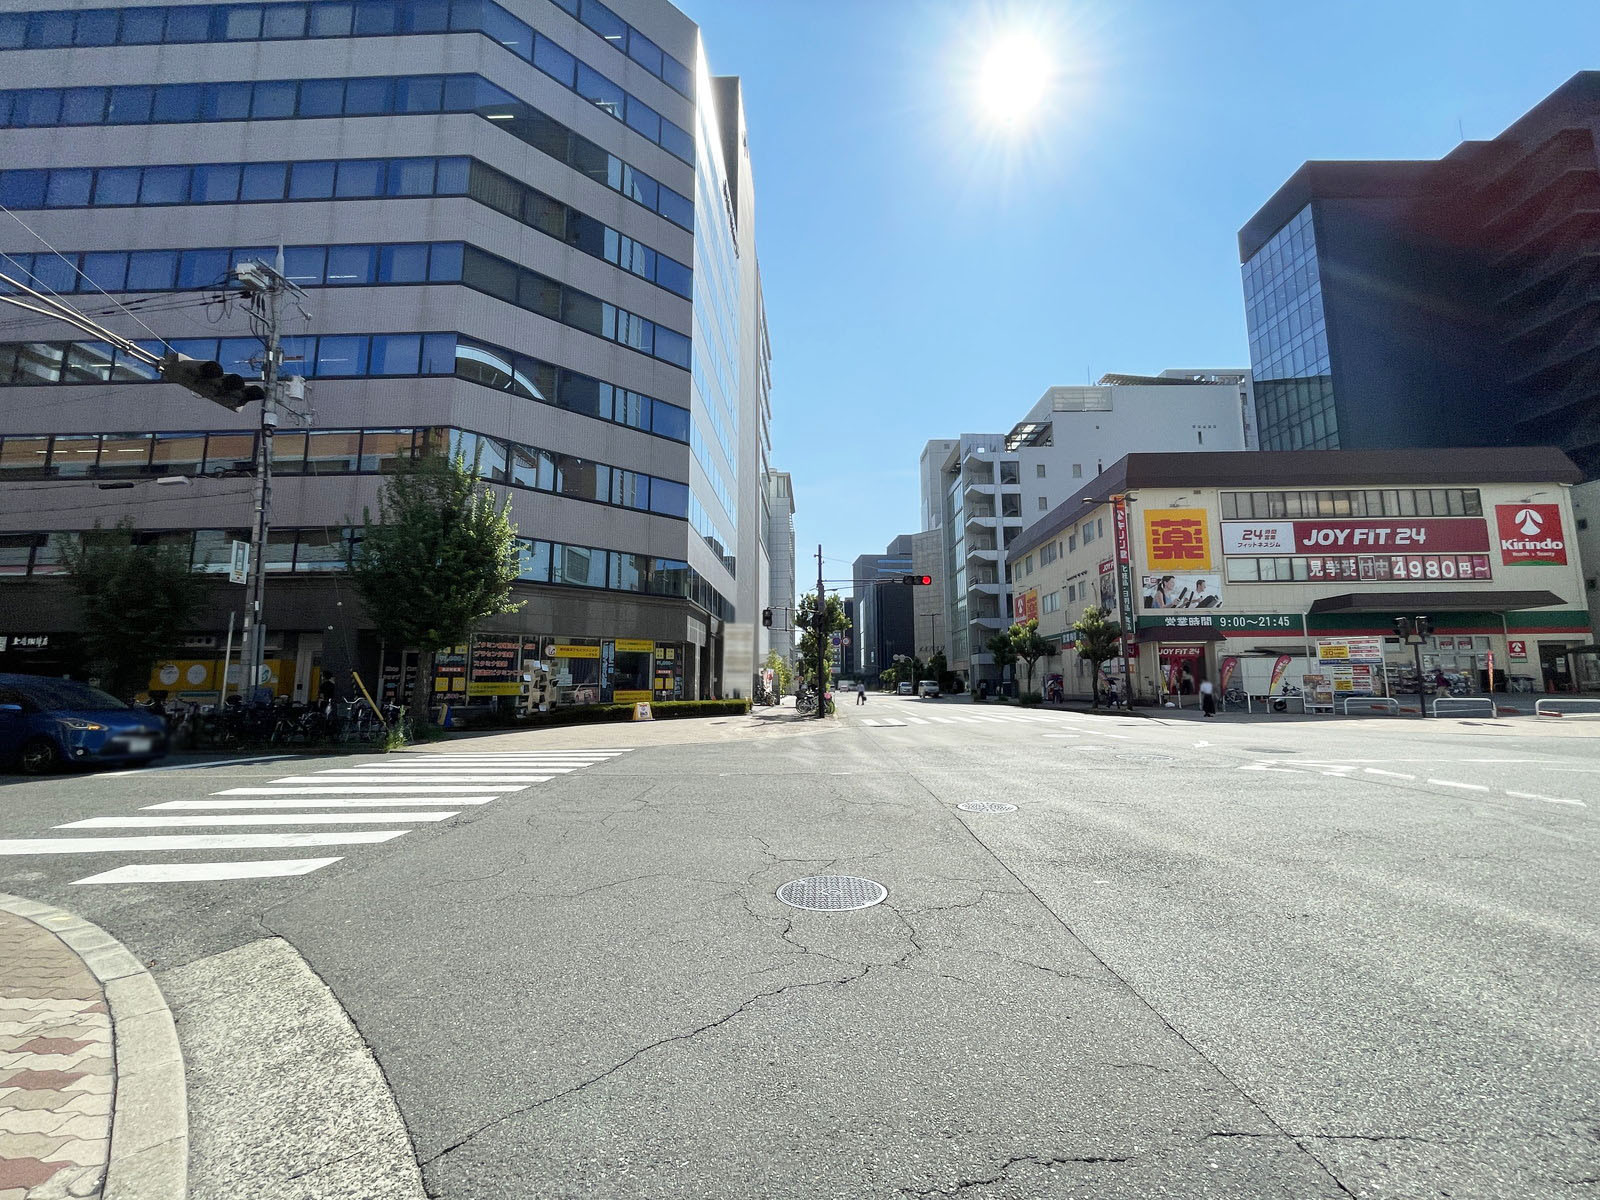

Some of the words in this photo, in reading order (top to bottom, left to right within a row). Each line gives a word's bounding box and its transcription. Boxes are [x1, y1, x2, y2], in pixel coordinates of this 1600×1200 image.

[1151, 519, 1204, 560] 薬
[1242, 529, 1263, 540] 24
[1303, 529, 1351, 546] JOY
[1353, 528, 1391, 545] FIT
[1395, 528, 1427, 545] 24
[1501, 538, 1564, 550] Kirindo
[1164, 616, 1213, 627] 営業時間
